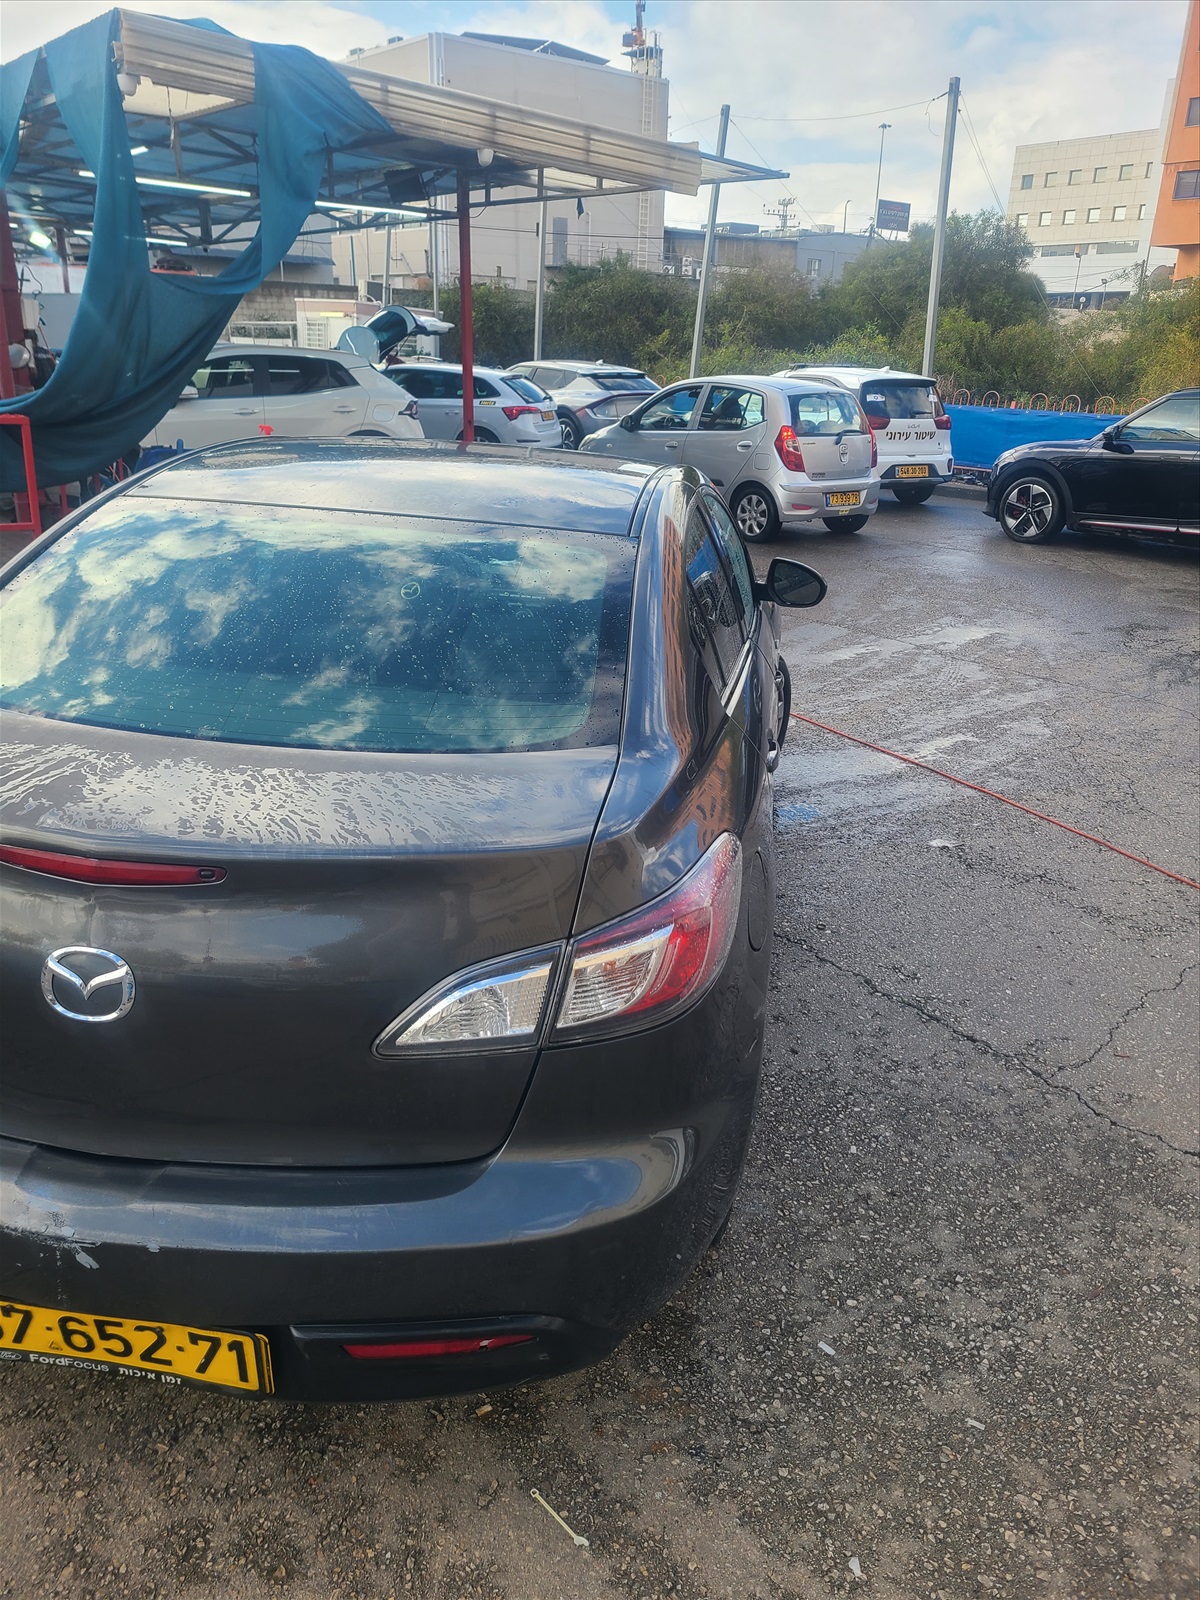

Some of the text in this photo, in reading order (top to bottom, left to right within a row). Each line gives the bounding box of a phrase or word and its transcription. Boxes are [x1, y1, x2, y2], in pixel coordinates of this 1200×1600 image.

[886, 431, 936, 441] שיטור עירוני
[0, 1304, 249, 1383] 7-652-71
[118, 1367, 156, 1380] איכות
